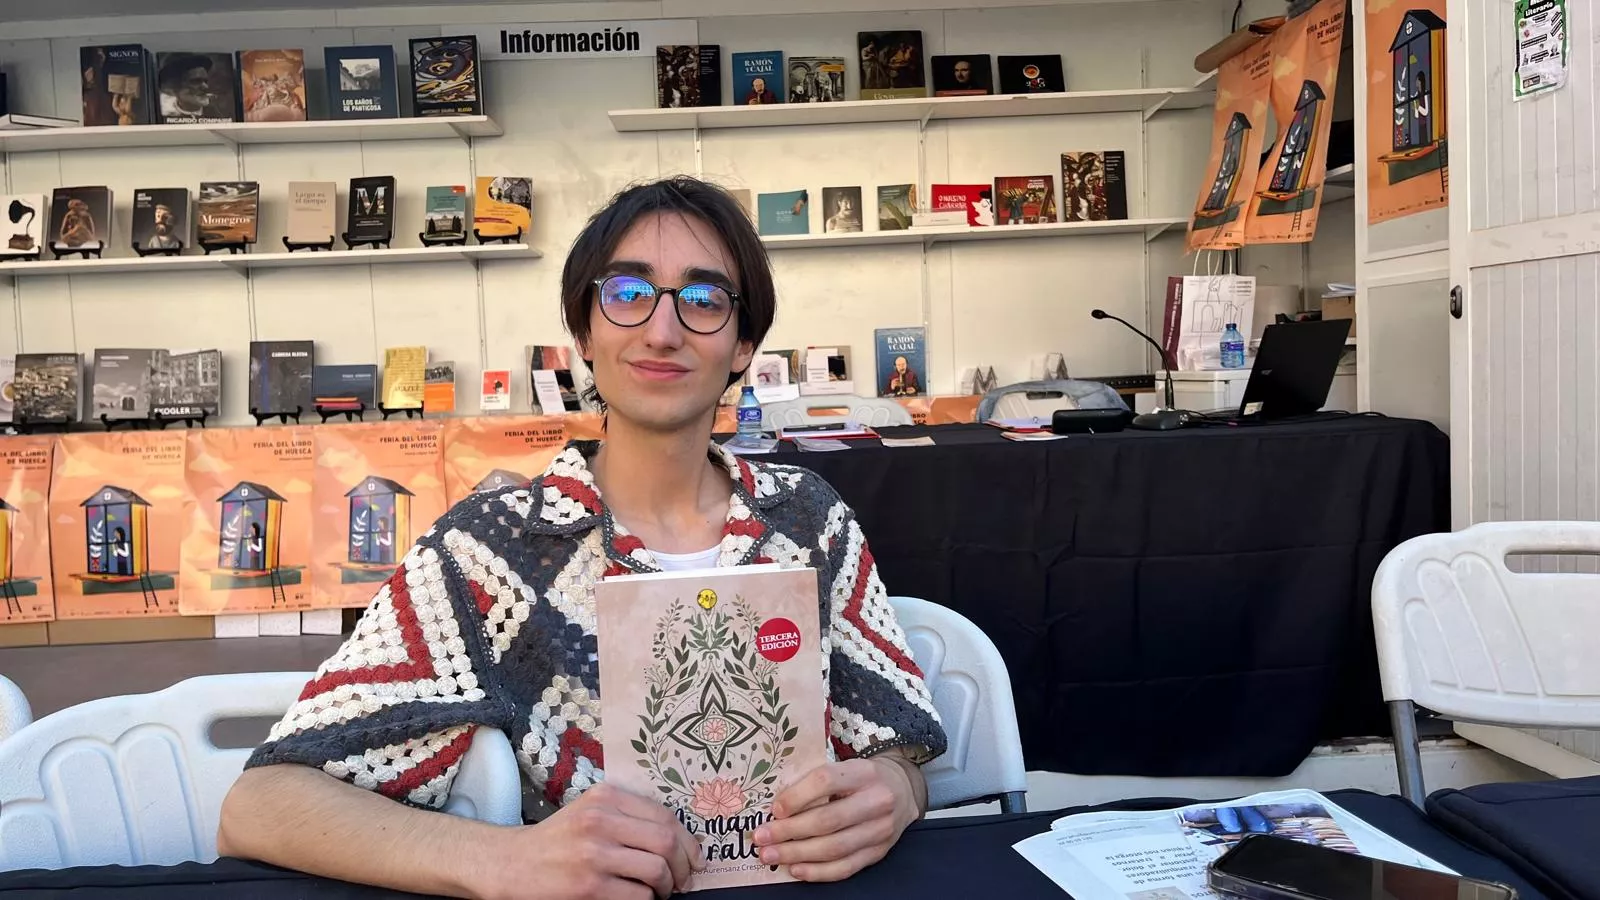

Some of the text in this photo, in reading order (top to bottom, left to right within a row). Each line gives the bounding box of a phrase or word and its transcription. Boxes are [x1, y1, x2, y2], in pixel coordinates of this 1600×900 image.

[1525, 2, 1553, 17] Literario
[500, 27, 640, 53] Información
[744, 58, 774, 67] RAMÓN
[354, 186, 388, 216] M
[202, 214, 250, 227] Monegros
[758, 632, 798, 643] TERCERA
[761, 640, 798, 651] EDICIÓN
[704, 863, 766, 876] Aurensanz Crespo
